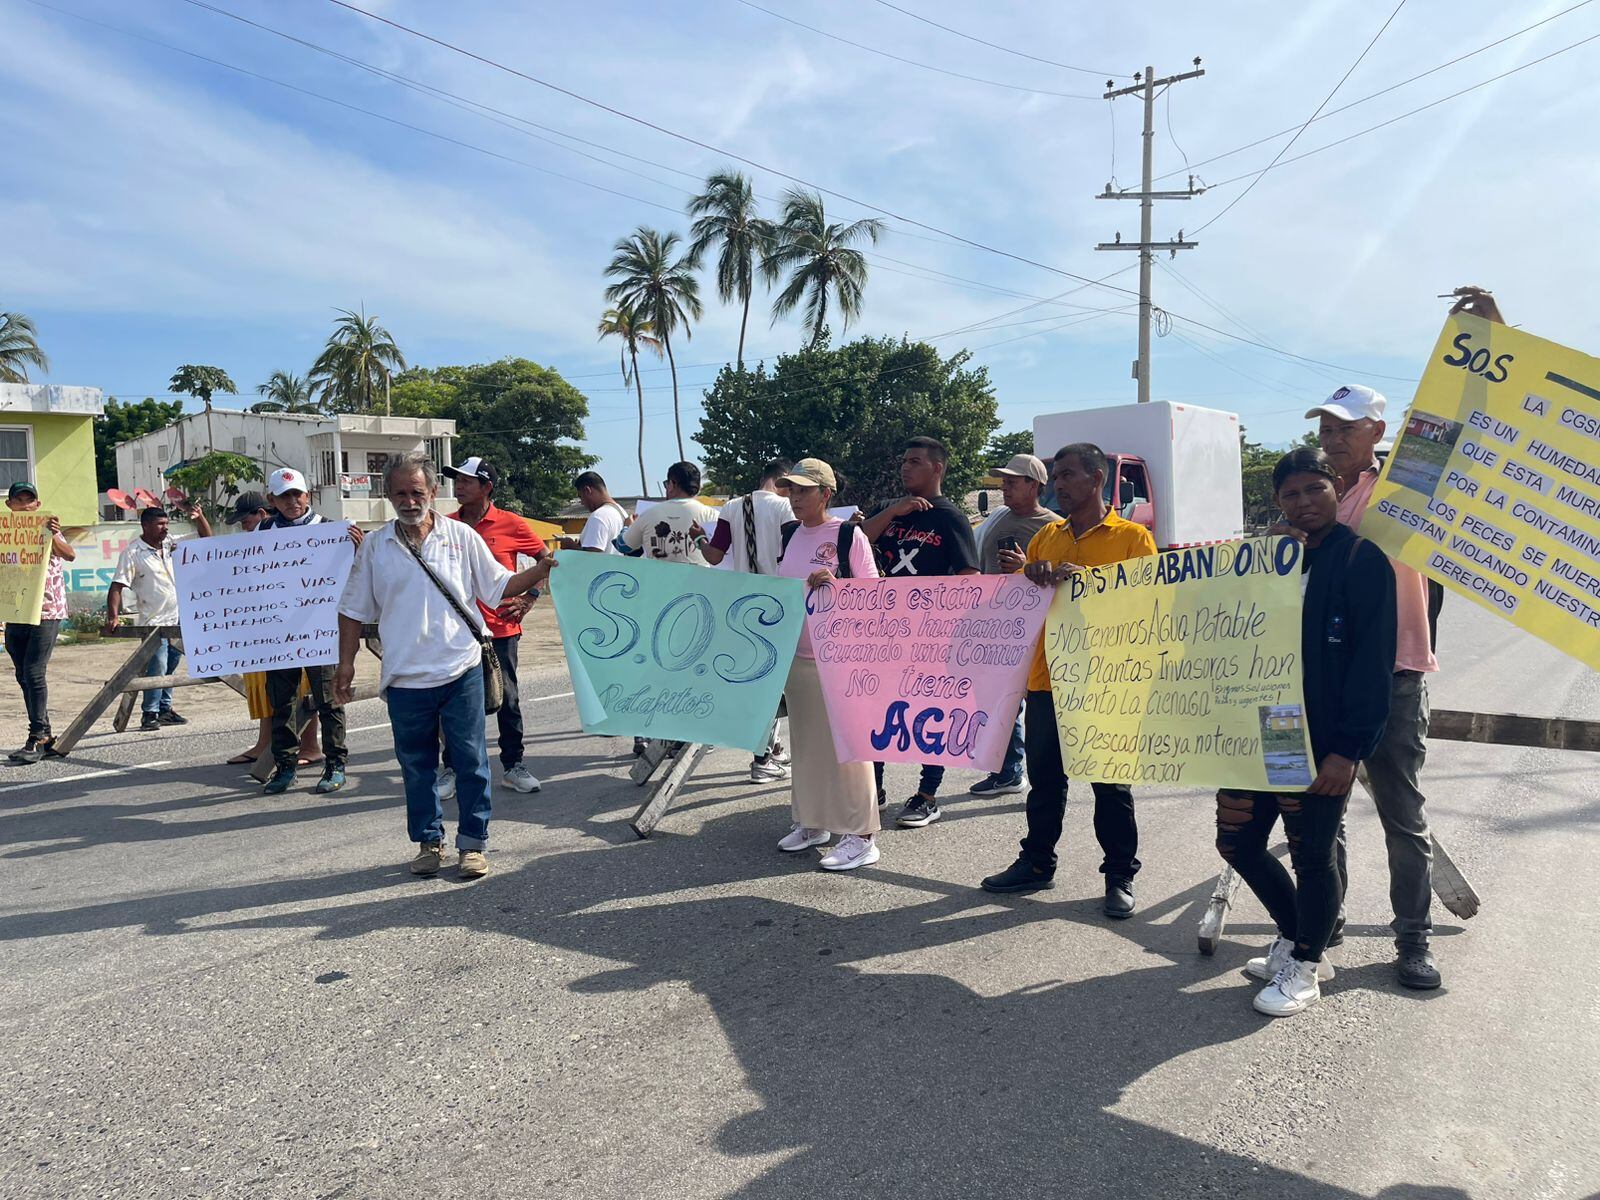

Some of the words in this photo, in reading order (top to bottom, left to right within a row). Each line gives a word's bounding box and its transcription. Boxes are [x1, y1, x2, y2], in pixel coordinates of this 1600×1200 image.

[1523, 396, 1546, 416] LA
[1468, 410, 1490, 430] ES
[1494, 421, 1519, 443] UN
[1445, 471, 1479, 498] POR
[1484, 489, 1505, 511] LA
[1461, 441, 1497, 467] QUE
[1501, 460, 1543, 492] ESTA
[1555, 485, 1600, 520] MURI
[1378, 500, 1400, 519] SE
[1399, 509, 1447, 543] ESTAN
[1451, 535, 1528, 587] VIOLANDO
[1426, 497, 1458, 523] LOS
[1460, 515, 1515, 552] PECES
[1522, 546, 1547, 567] SE
[1130, 557, 1153, 588] de
[1154, 536, 1300, 586] ABANDONO
[217, 581, 286, 596] TENEMOS
[300, 576, 337, 590] VIAS
[1431, 554, 1517, 609] DERECHOS
[225, 636, 282, 649] TENEMOS
[813, 610, 912, 640] derechos
[917, 611, 1026, 639] humanos
[227, 652, 294, 669] TENEMOS
[910, 642, 953, 664] una
[1084, 653, 1153, 684] Plantas
[1249, 644, 1296, 679] han
[845, 668, 881, 697] No
[898, 664, 973, 699] tiene
